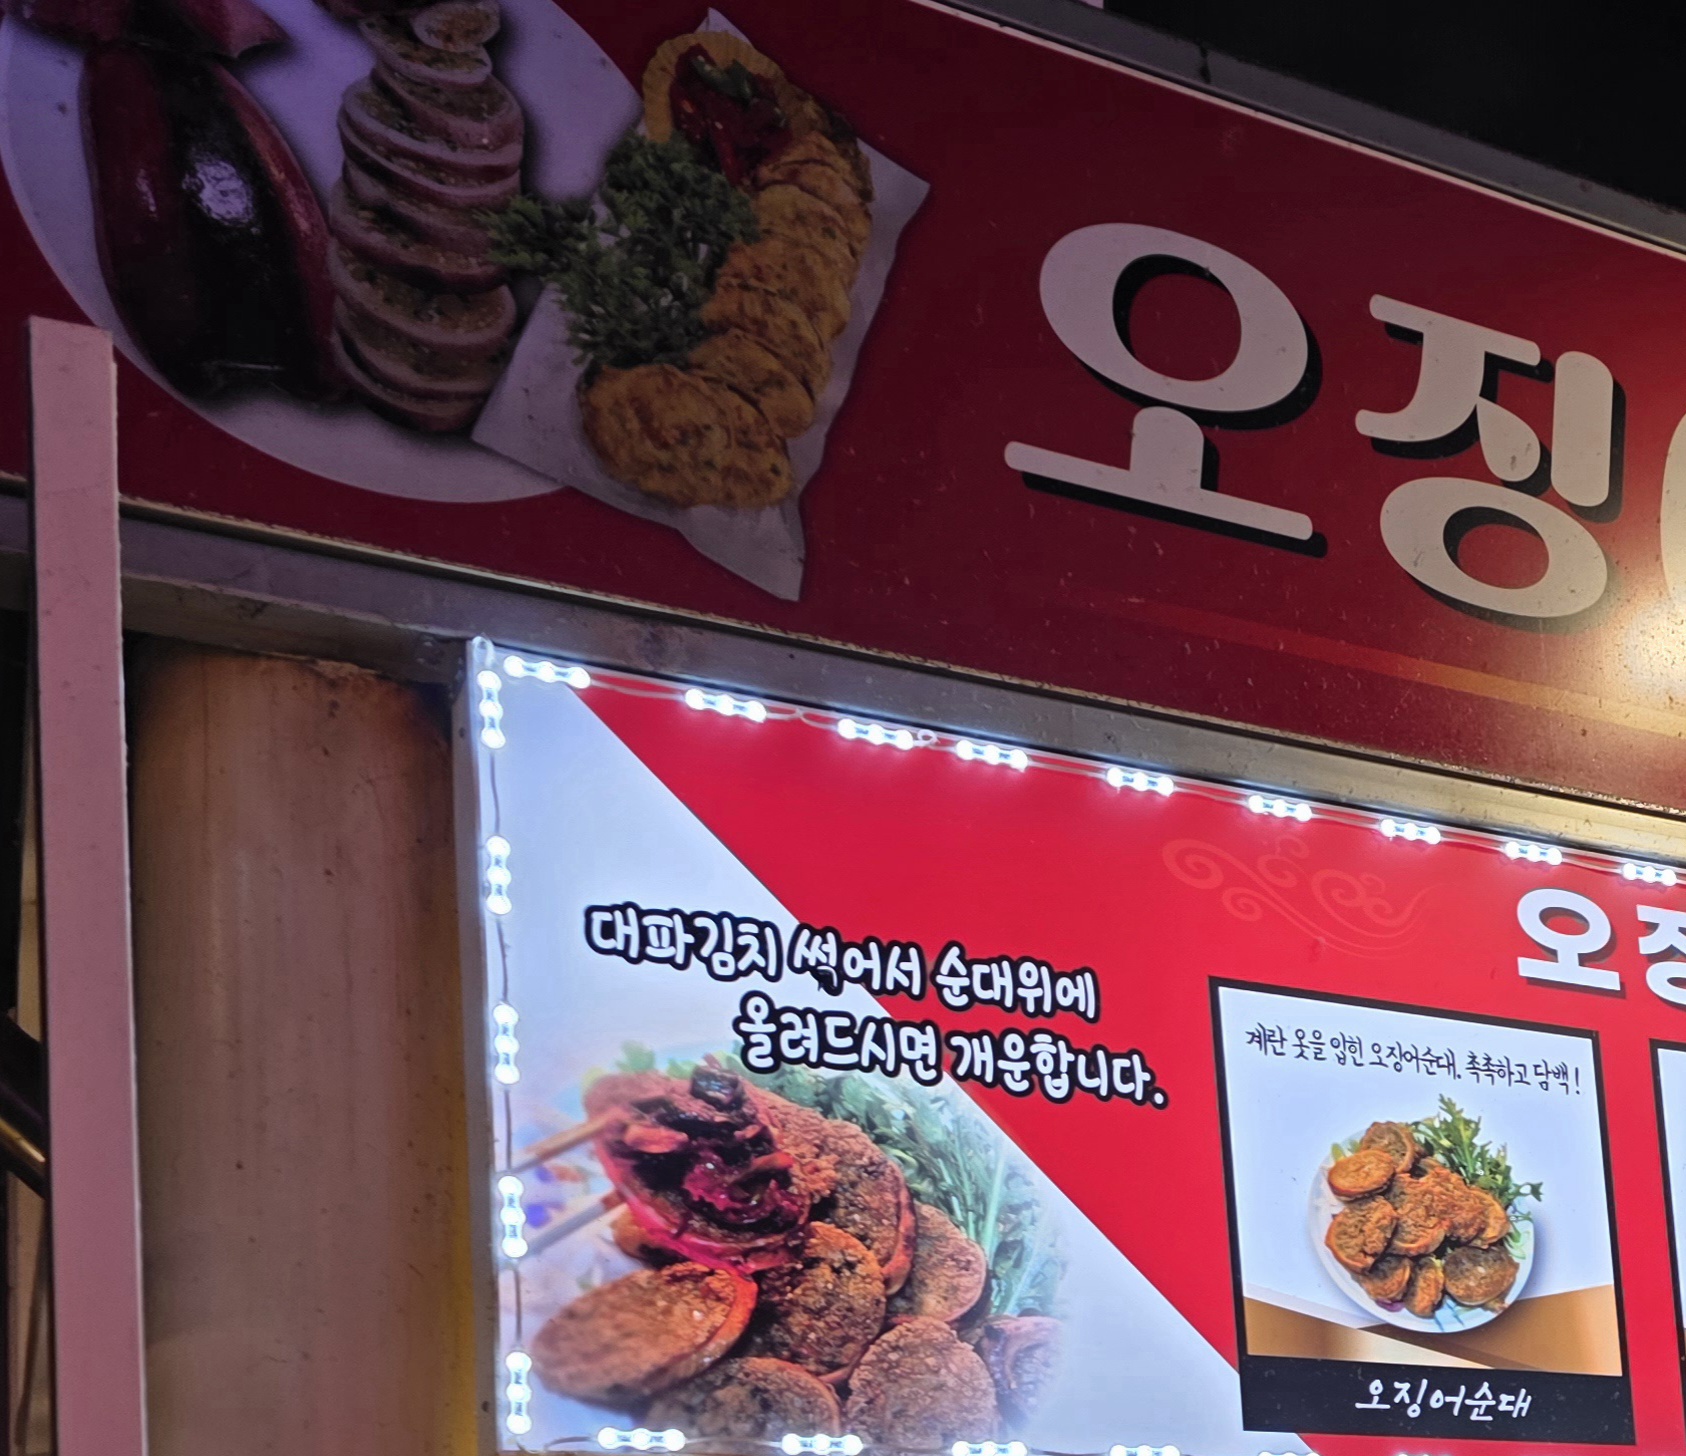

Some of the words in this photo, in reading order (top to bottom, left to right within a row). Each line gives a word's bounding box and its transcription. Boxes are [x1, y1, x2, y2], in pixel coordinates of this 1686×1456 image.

[586, 903, 785, 981] 대파김치
[932, 942, 1102, 1024] 순대위에
[732, 990, 944, 1086] 올려드시면
[947, 1029, 1170, 1110] 개운합니다.
[1245, 1022, 1287, 1058] 계란
[1291, 1027, 1327, 1062] 옷을
[1329, 1034, 1365, 1068] 입힌
[1464, 1050, 1533, 1089] 촉촉하고
[1355, 1379, 1533, 1420] 오징어순대
